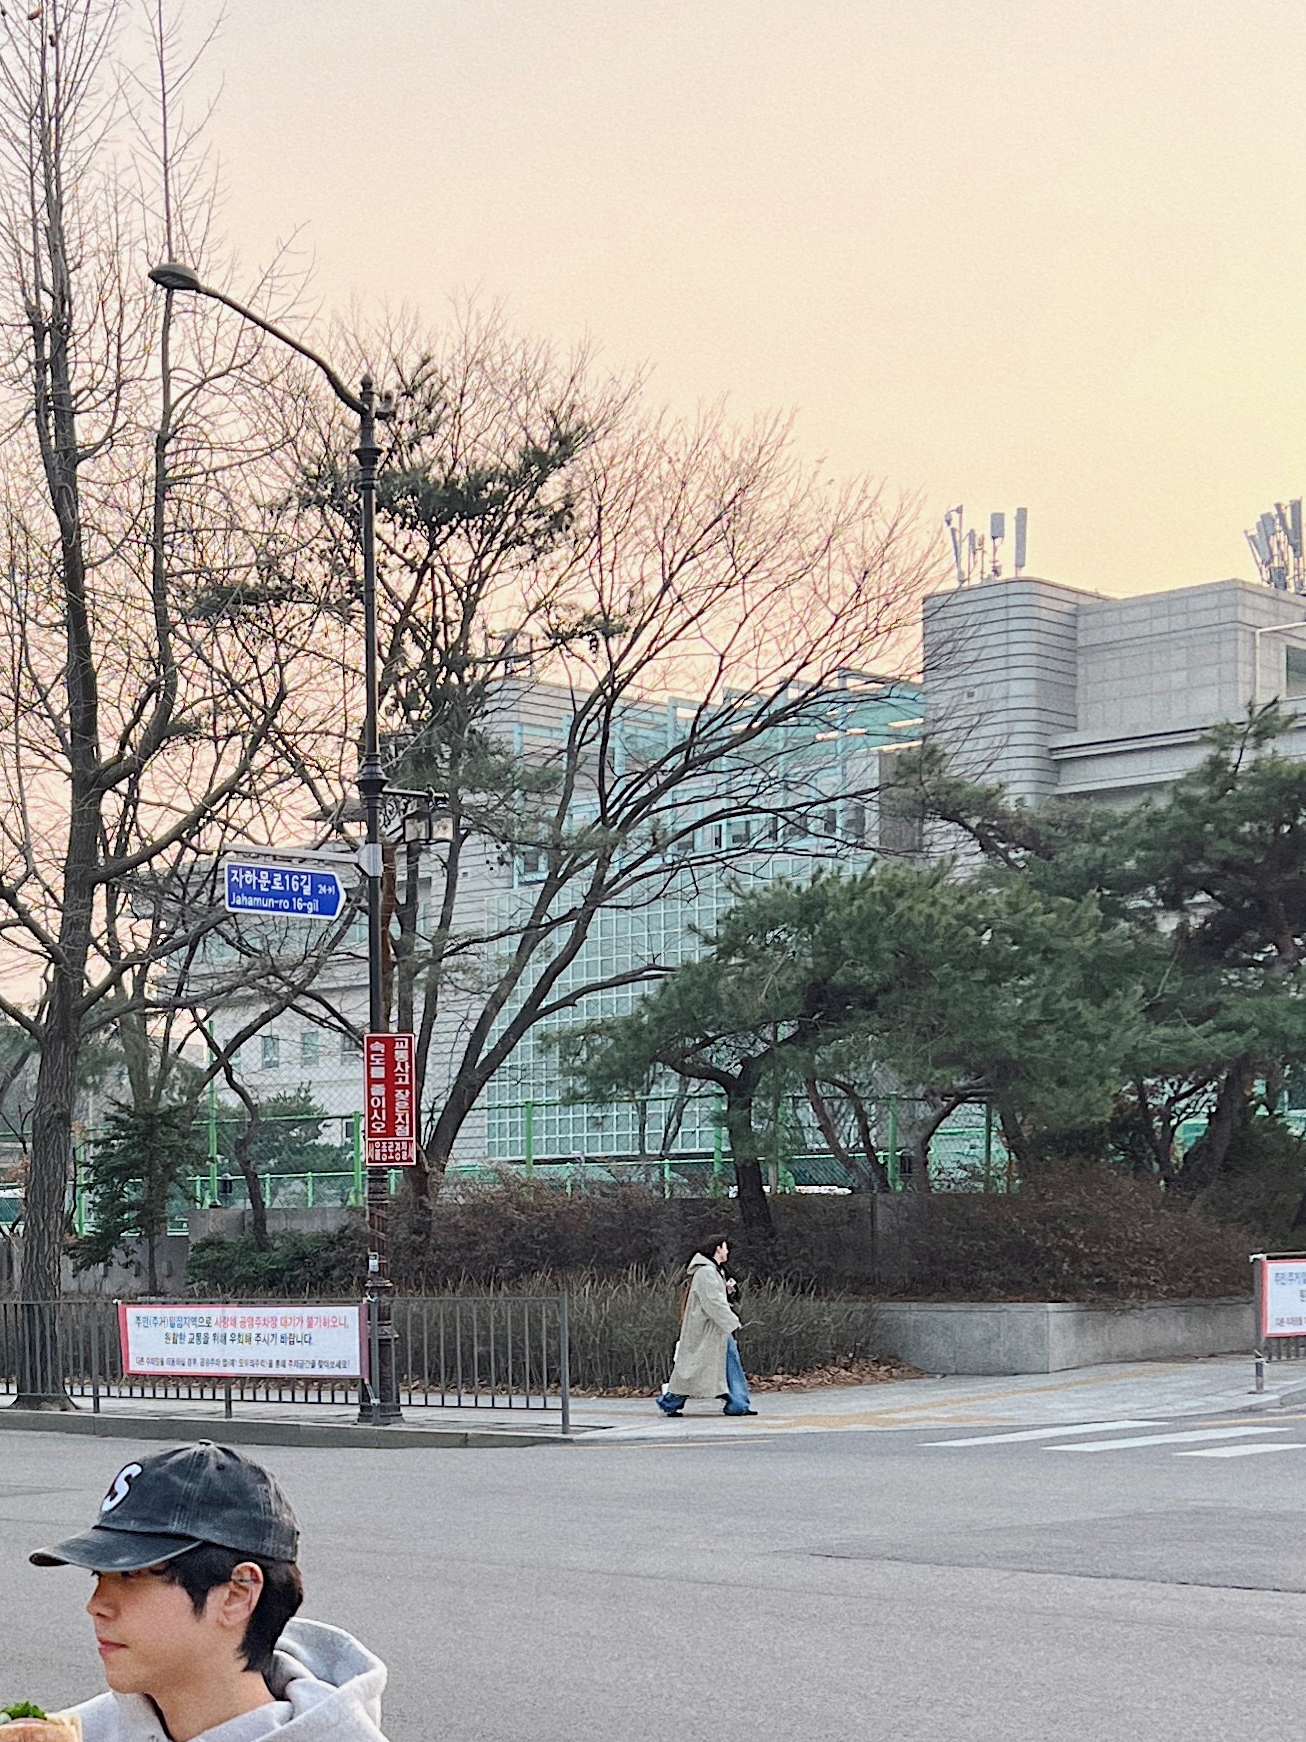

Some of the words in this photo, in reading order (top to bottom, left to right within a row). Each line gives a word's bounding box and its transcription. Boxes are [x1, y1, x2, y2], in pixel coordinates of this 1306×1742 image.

[230, 868, 312, 896] 자하문로16길
[230, 892, 290, 909] Jahamun-ro
[292, 897, 319, 914] 16-gil
[369, 1041, 386, 1079] 속도를
[393, 1037, 410, 1085] 교통사고
[370, 1083, 387, 1134] 줄이시오
[188, 1332, 210, 1345] 교통을
[254, 1333, 278, 1345] 주시기
[101, 1463, 143, 1512] S
